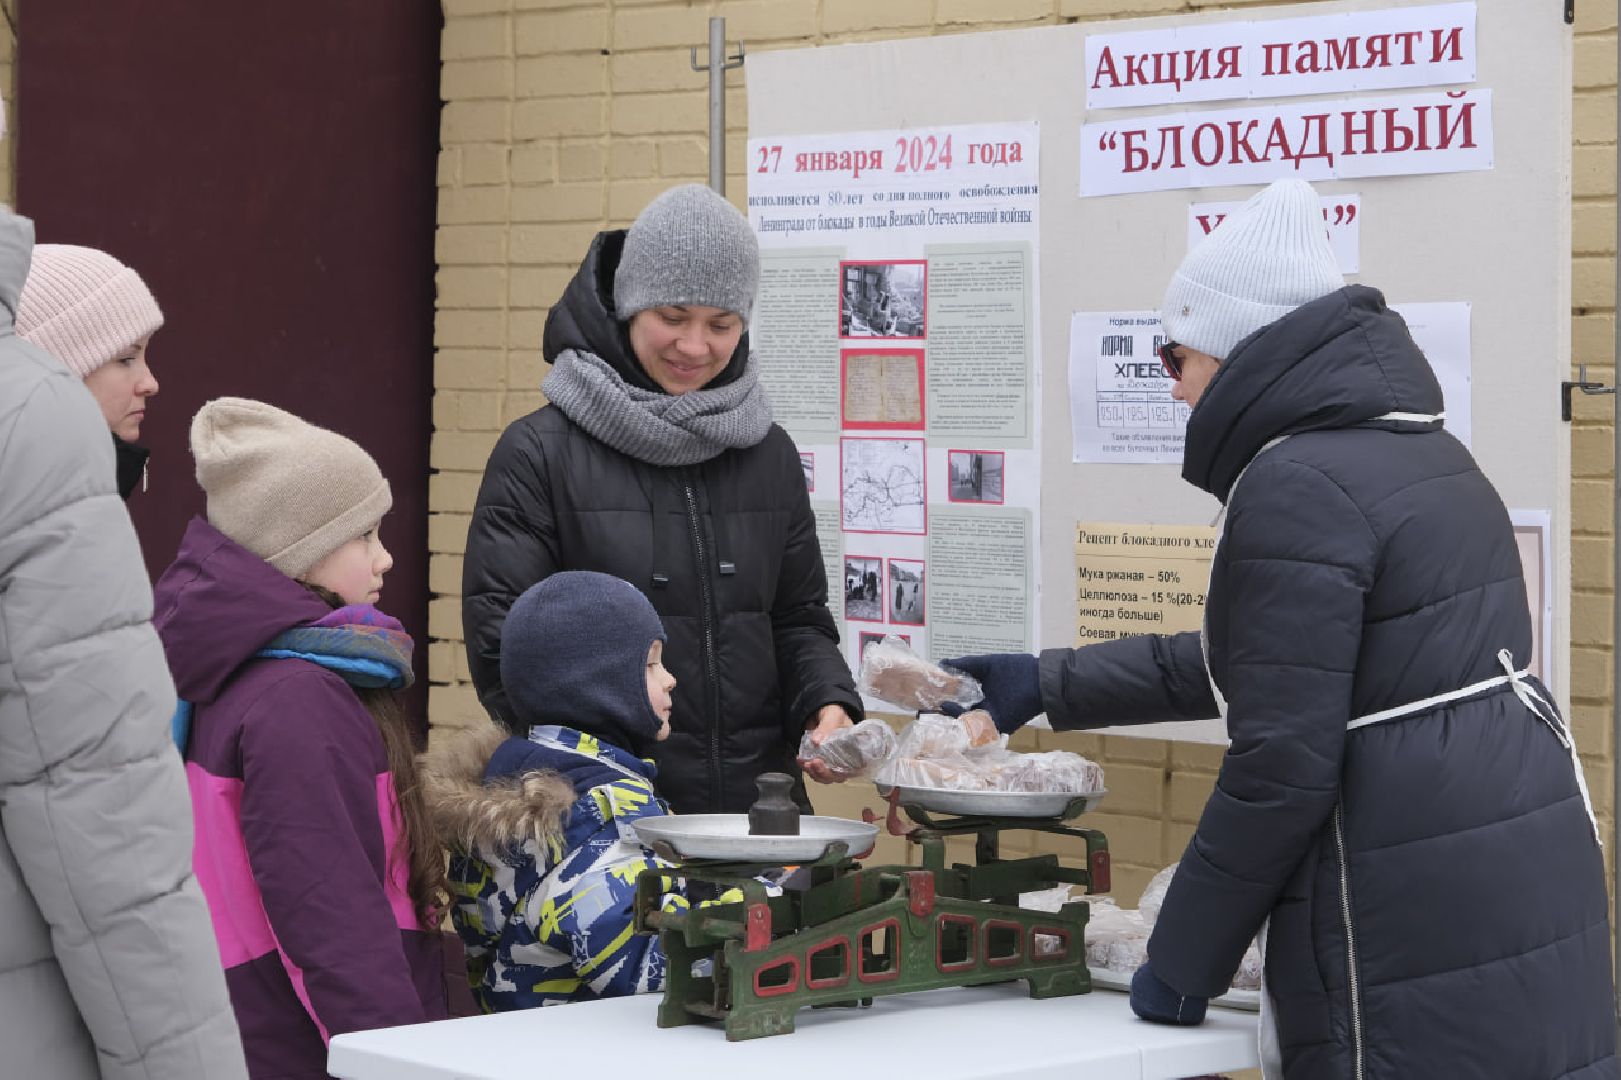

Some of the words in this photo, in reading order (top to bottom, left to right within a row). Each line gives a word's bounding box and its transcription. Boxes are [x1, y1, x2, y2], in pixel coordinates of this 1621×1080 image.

[1090, 45, 1243, 92] Акция
[1261, 26, 1463, 76] памяти
[757, 145, 782, 173] 27
[795, 149, 883, 178] января
[894, 134, 953, 173] 2024
[967, 140, 1023, 168] года
[749, 195, 820, 206] исполняется
[888, 191, 905, 202] дня
[908, 191, 950, 202] полного
[958, 184, 1038, 197] освобождения
[758, 216, 804, 237] Ленинграда
[805, 218, 816, 231] от
[818, 213, 854, 231] блокады
[866, 215, 887, 230] годы
[889, 209, 926, 227] Великой
[927, 207, 997, 226] Отечественной
[1078, 530, 1118, 545] Рецепт
[1122, 532, 1190, 547] блокадного
[1079, 567, 1104, 582] Мука
[1107, 571, 1144, 582] ржаная
[1157, 571, 1181, 583] 50%
[1079, 588, 1138, 602] Целлюлоза
[1152, 591, 1163, 603] 15
[1080, 608, 1115, 619] иногда
[1118, 607, 1163, 624] больше)
[1080, 625, 1116, 639] Соевая
